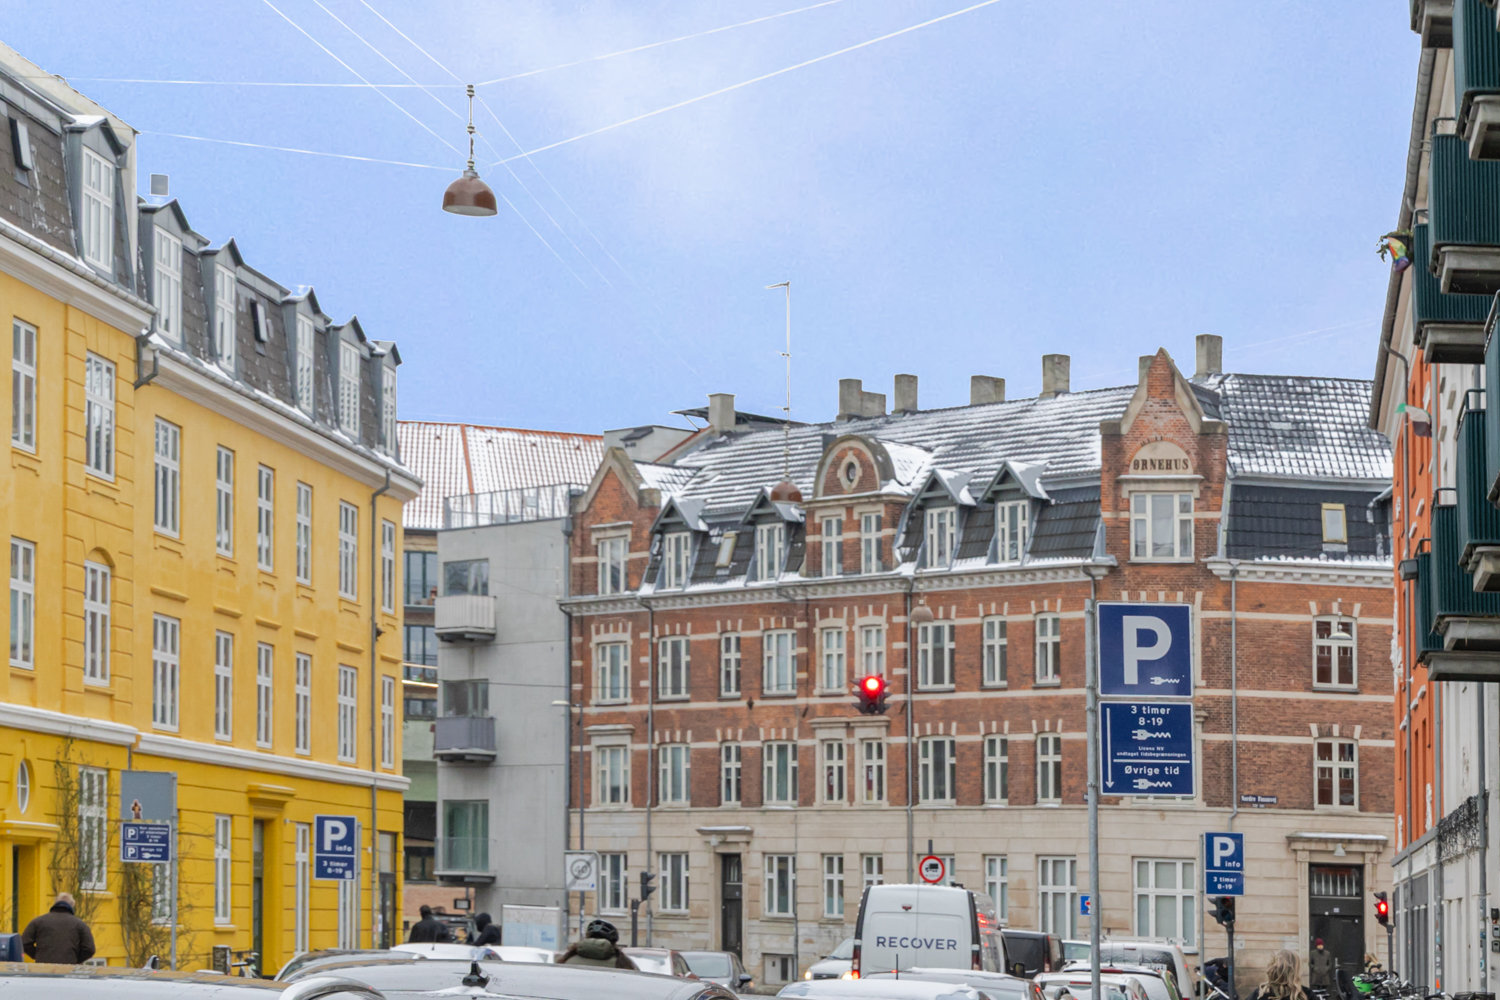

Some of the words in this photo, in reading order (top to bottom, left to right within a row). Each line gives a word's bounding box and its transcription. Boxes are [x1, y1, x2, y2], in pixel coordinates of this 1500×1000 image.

[1122, 615, 1172, 685] P
[1130, 705, 1138, 714] 3
[1142, 705, 1171, 715] timer
[1138, 717, 1163, 726] 8-19
[1124, 765, 1160, 776] Øvrige
[1164, 766, 1180, 775] tid
[128, 828, 136, 838] P
[323, 820, 347, 851] P
[128, 847, 136, 857] P
[335, 844, 353, 852] info
[1213, 836, 1235, 867] P
[1224, 860, 1241, 868] info
[876, 936, 957, 950] RECOVER
